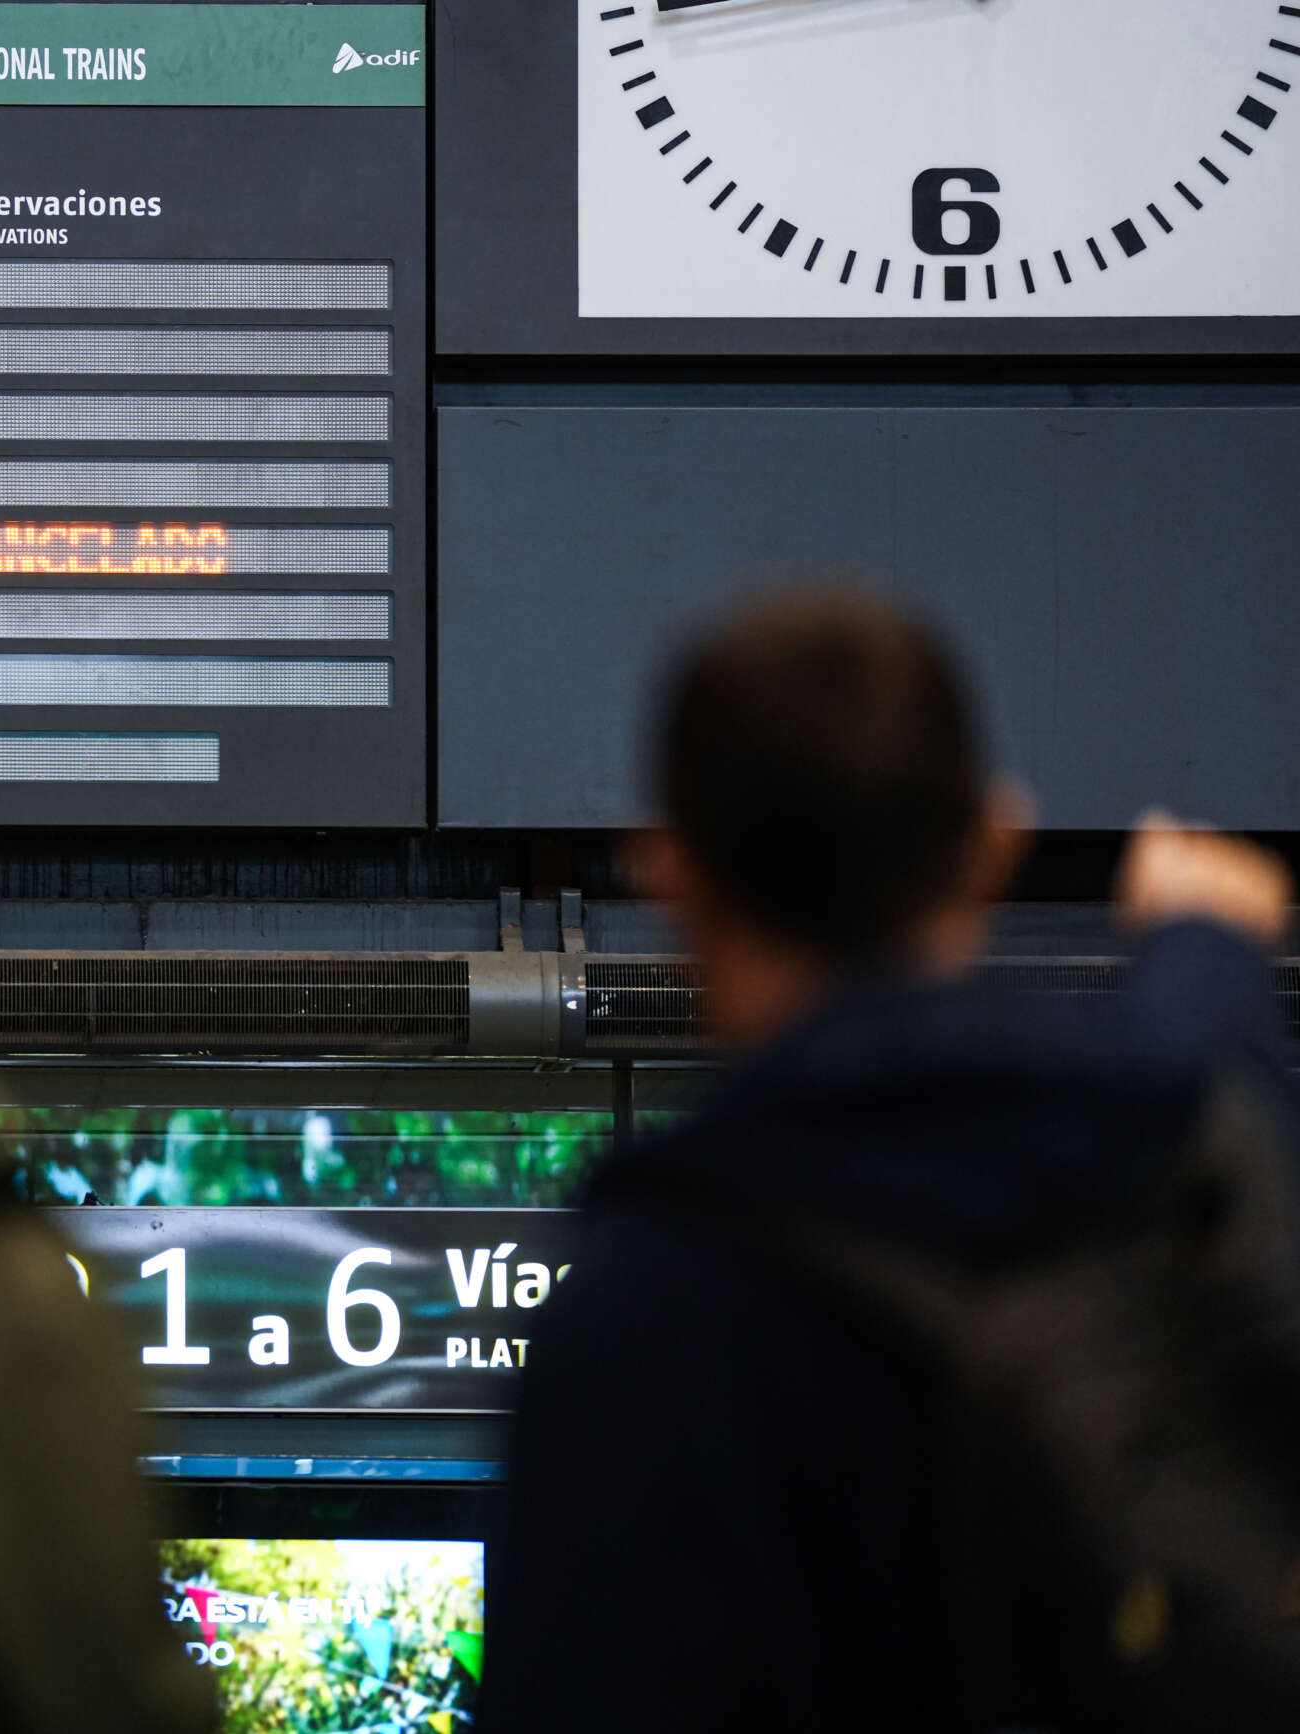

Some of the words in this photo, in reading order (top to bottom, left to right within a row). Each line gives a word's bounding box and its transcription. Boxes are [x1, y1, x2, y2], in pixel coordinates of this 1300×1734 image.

[63, 48, 146, 80] TRAINS
[366, 50, 420, 65] adif
[912, 168, 1000, 255] 6
[446, 1243, 571, 1307] Vía
[141, 1248, 209, 1365] 1
[249, 1315, 288, 1365] a
[326, 1248, 400, 1367] 6
[446, 1338, 529, 1367] PLAT
[206, 1591, 284, 1624] ESTÁ
[288, 1597, 332, 1624] EN
